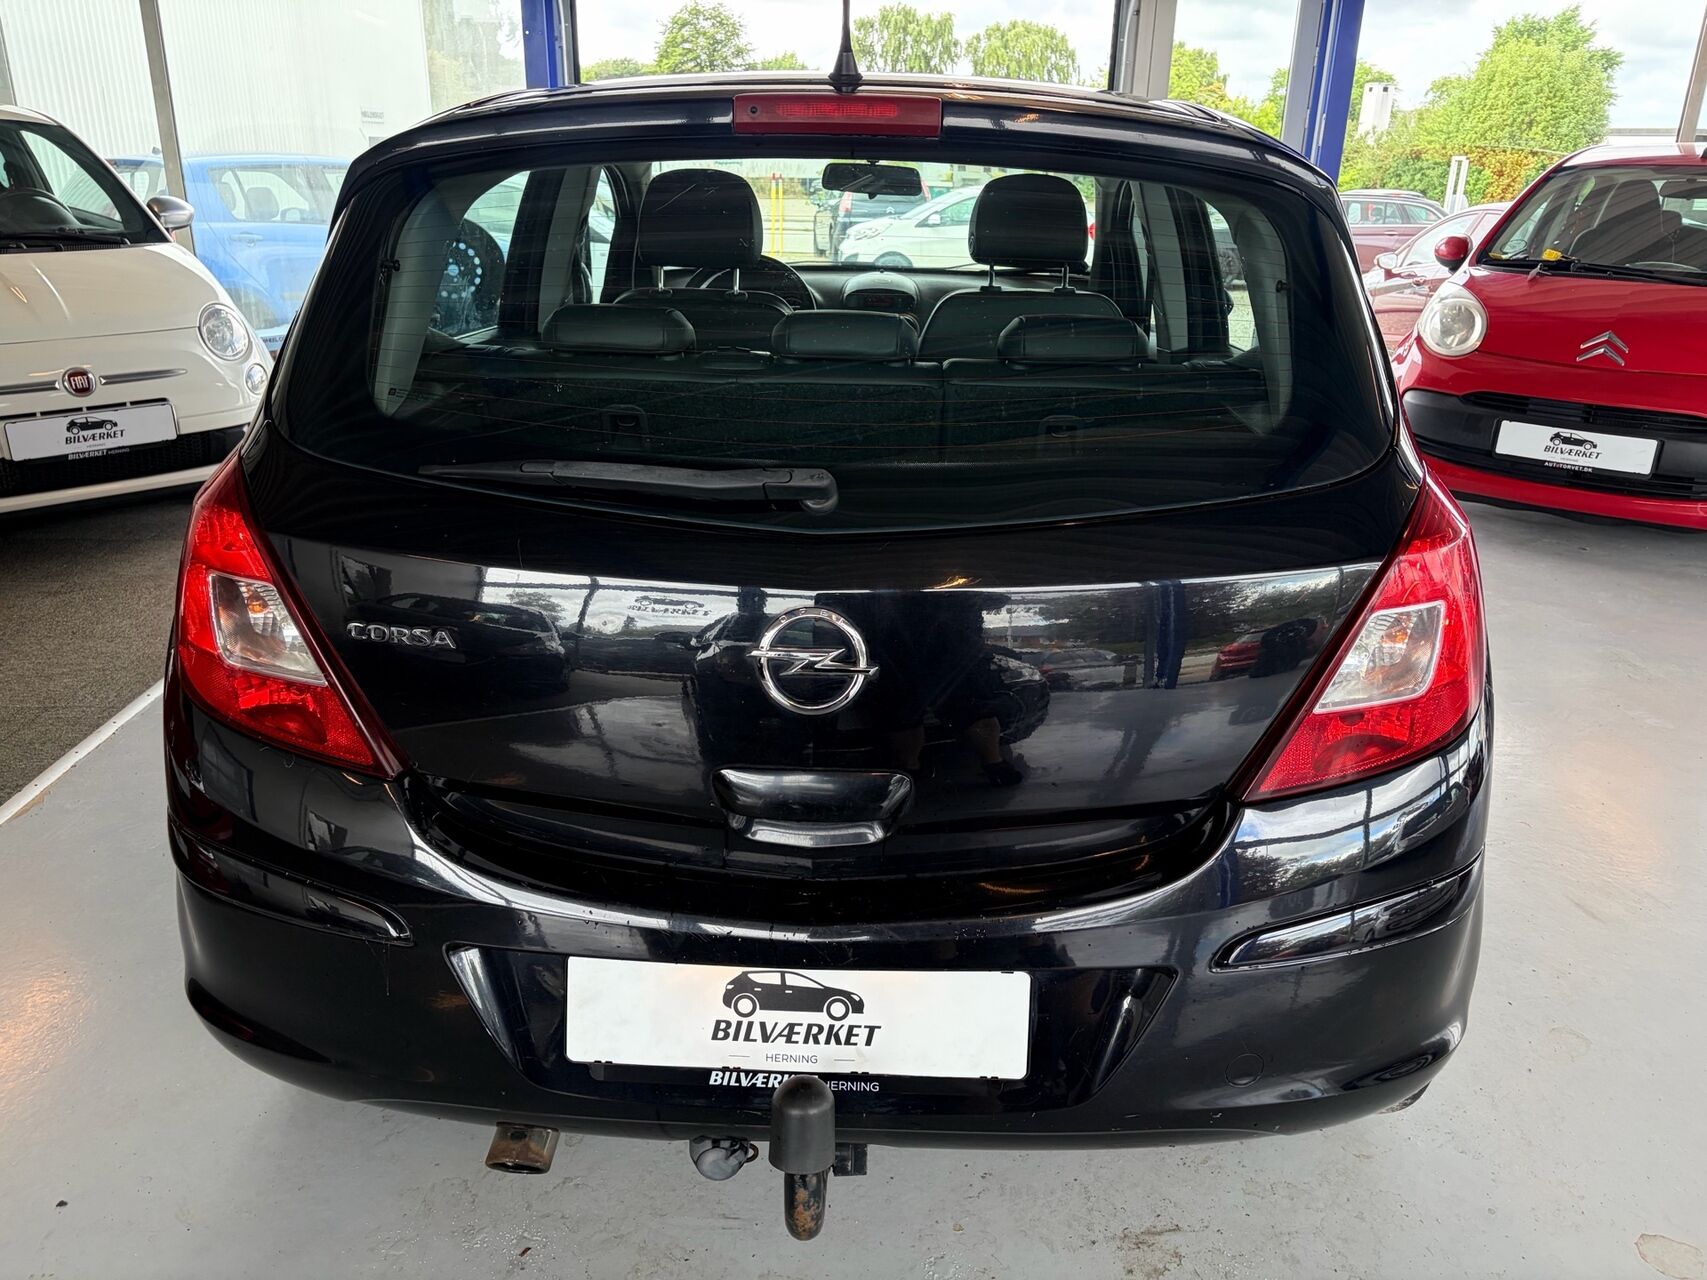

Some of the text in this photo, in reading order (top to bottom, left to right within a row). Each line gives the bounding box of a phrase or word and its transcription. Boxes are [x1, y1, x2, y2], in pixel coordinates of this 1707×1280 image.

[70, 375, 89, 390] FIAT
[65, 429, 126, 445] BILVÆRKET
[1543, 444, 1603, 459] BILVÆRKET
[346, 622, 457, 650] CORSA
[711, 1019, 882, 1047] BILVÆRKET
[765, 1053, 818, 1064] HERNING
